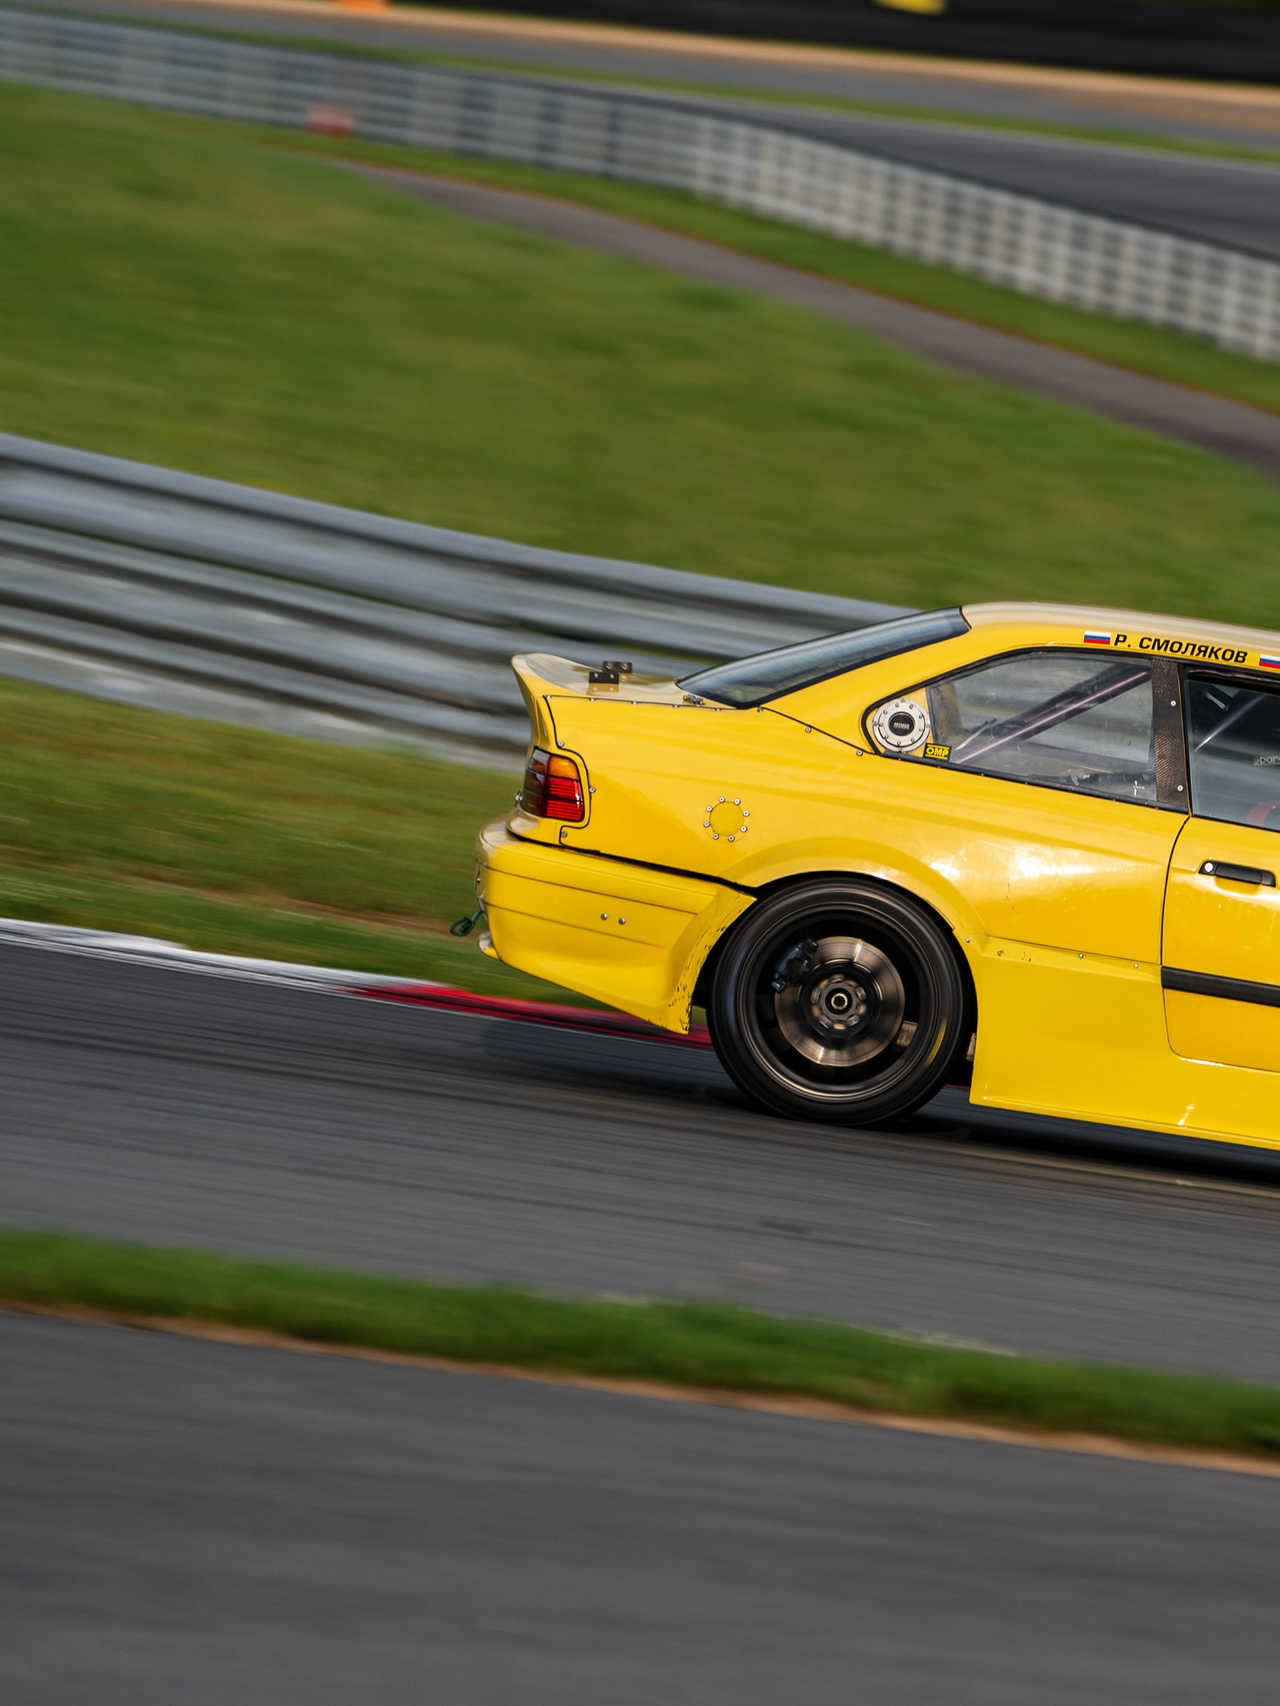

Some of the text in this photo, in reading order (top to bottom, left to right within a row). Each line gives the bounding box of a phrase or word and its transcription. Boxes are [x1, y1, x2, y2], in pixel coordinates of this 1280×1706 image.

[1113, 634, 1248, 663] Р. СМОЛЯКОВ
[926, 747, 949, 758] OMP
